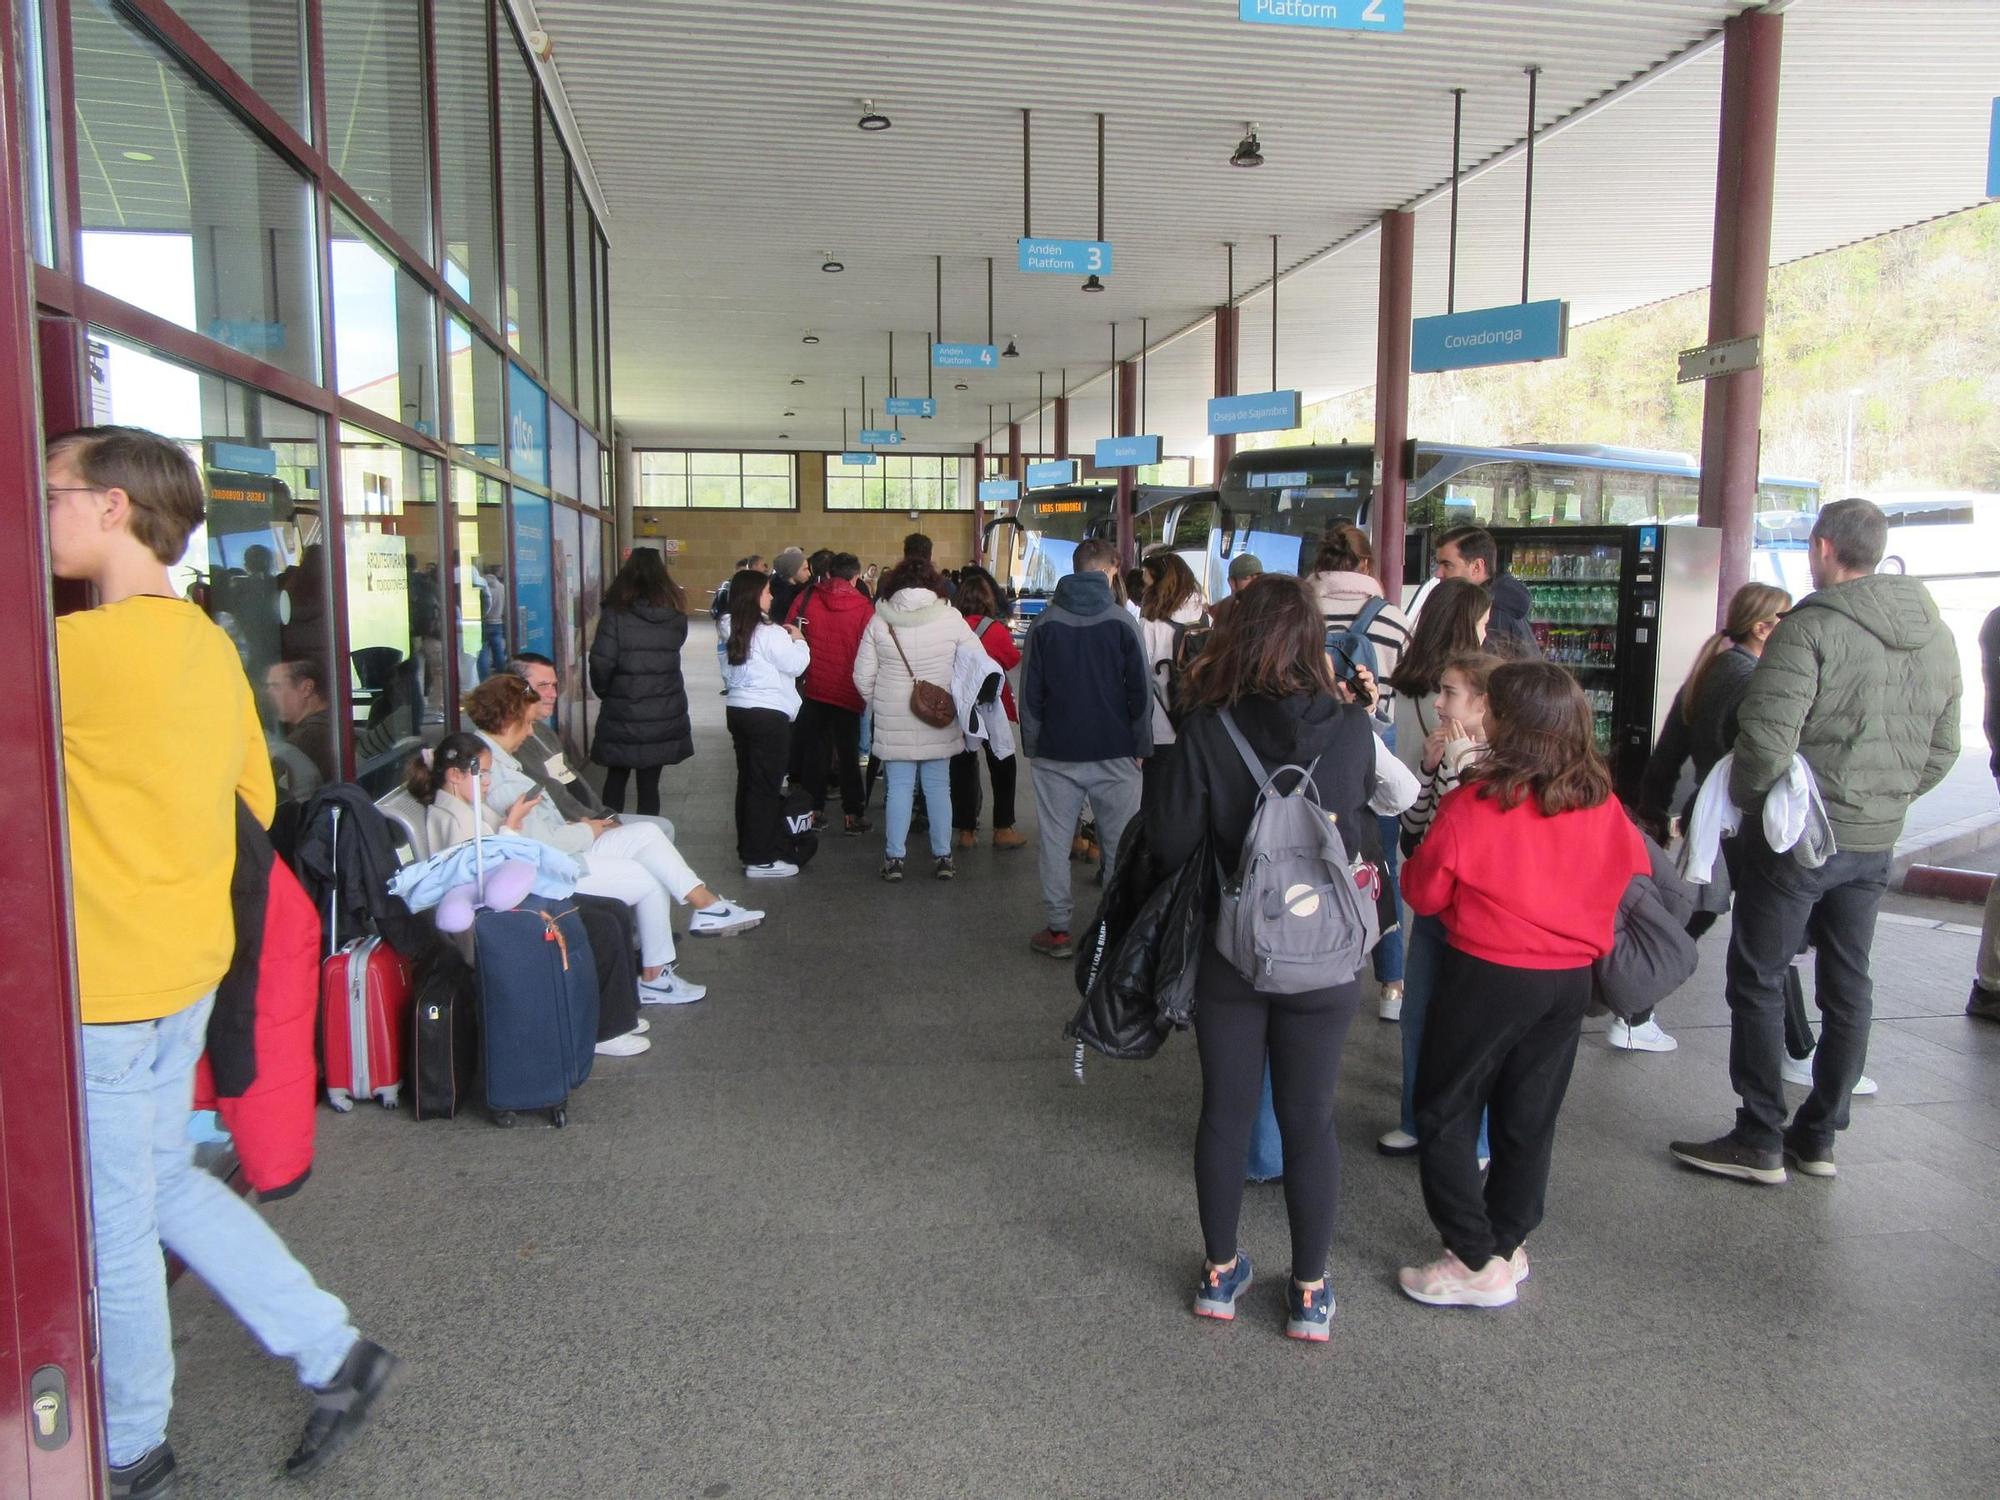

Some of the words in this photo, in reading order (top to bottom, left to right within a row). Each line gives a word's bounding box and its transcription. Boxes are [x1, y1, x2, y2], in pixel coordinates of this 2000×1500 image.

[1257, 0, 1336, 19] Platform
[1028, 244, 1062, 255] Andén
[1028, 258, 1074, 269] Platform
[1087, 247, 1102, 270] 3
[1444, 328, 1522, 348] Covadonga
[980, 349, 992, 365] 4
[923, 401, 931, 414] 5
[890, 433, 897, 443] 6
[867, 455, 873, 464] 7
[1092, 946, 1104, 966] LOLA
